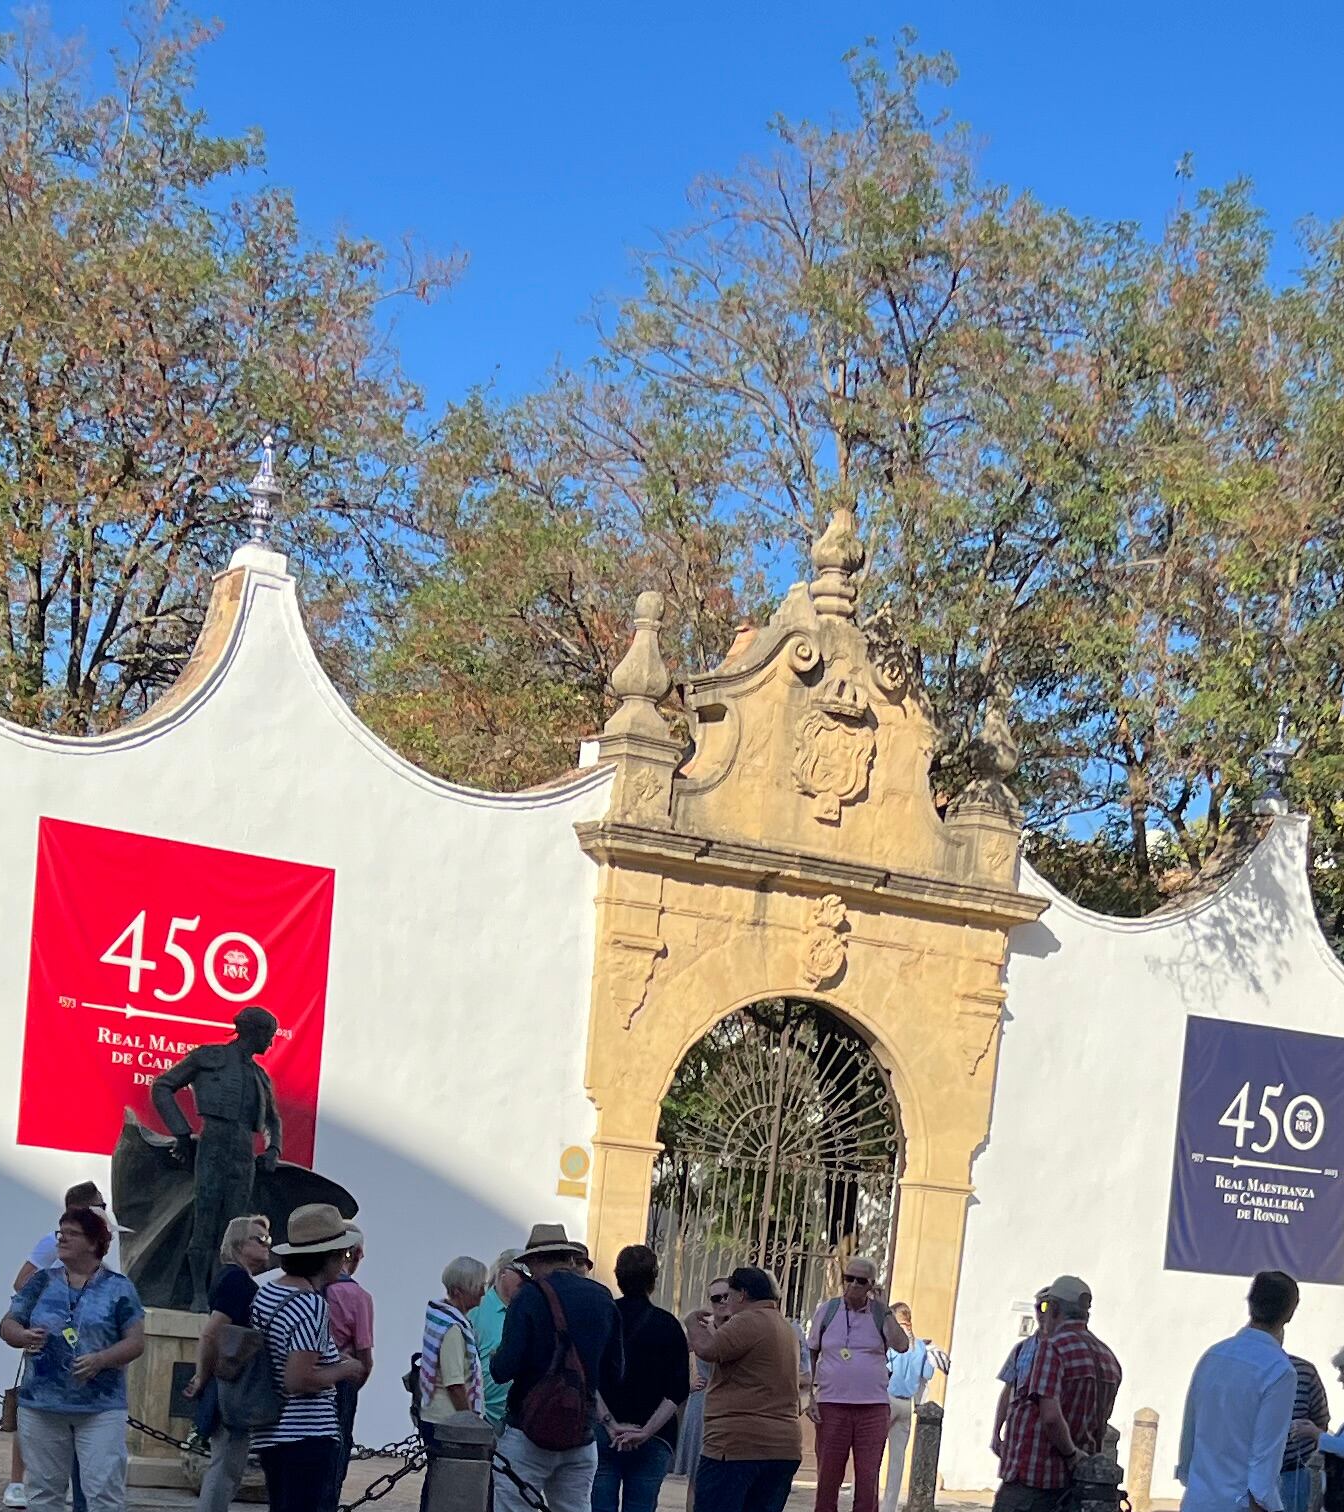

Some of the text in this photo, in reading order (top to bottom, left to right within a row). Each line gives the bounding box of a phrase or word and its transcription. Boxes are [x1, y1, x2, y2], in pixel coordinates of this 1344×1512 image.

[99, 909, 268, 1003] 450
[97, 1026, 144, 1048] REAL
[275, 1028, 293, 1040] 023
[111, 1050, 133, 1066] DE
[1218, 1081, 1325, 1153] 450
[1215, 1174, 1315, 1198] REAL MAESTRANZA
[1223, 1192, 1305, 1212] DE CABALLERÍA
[1236, 1208, 1289, 1224] DE RONDA
